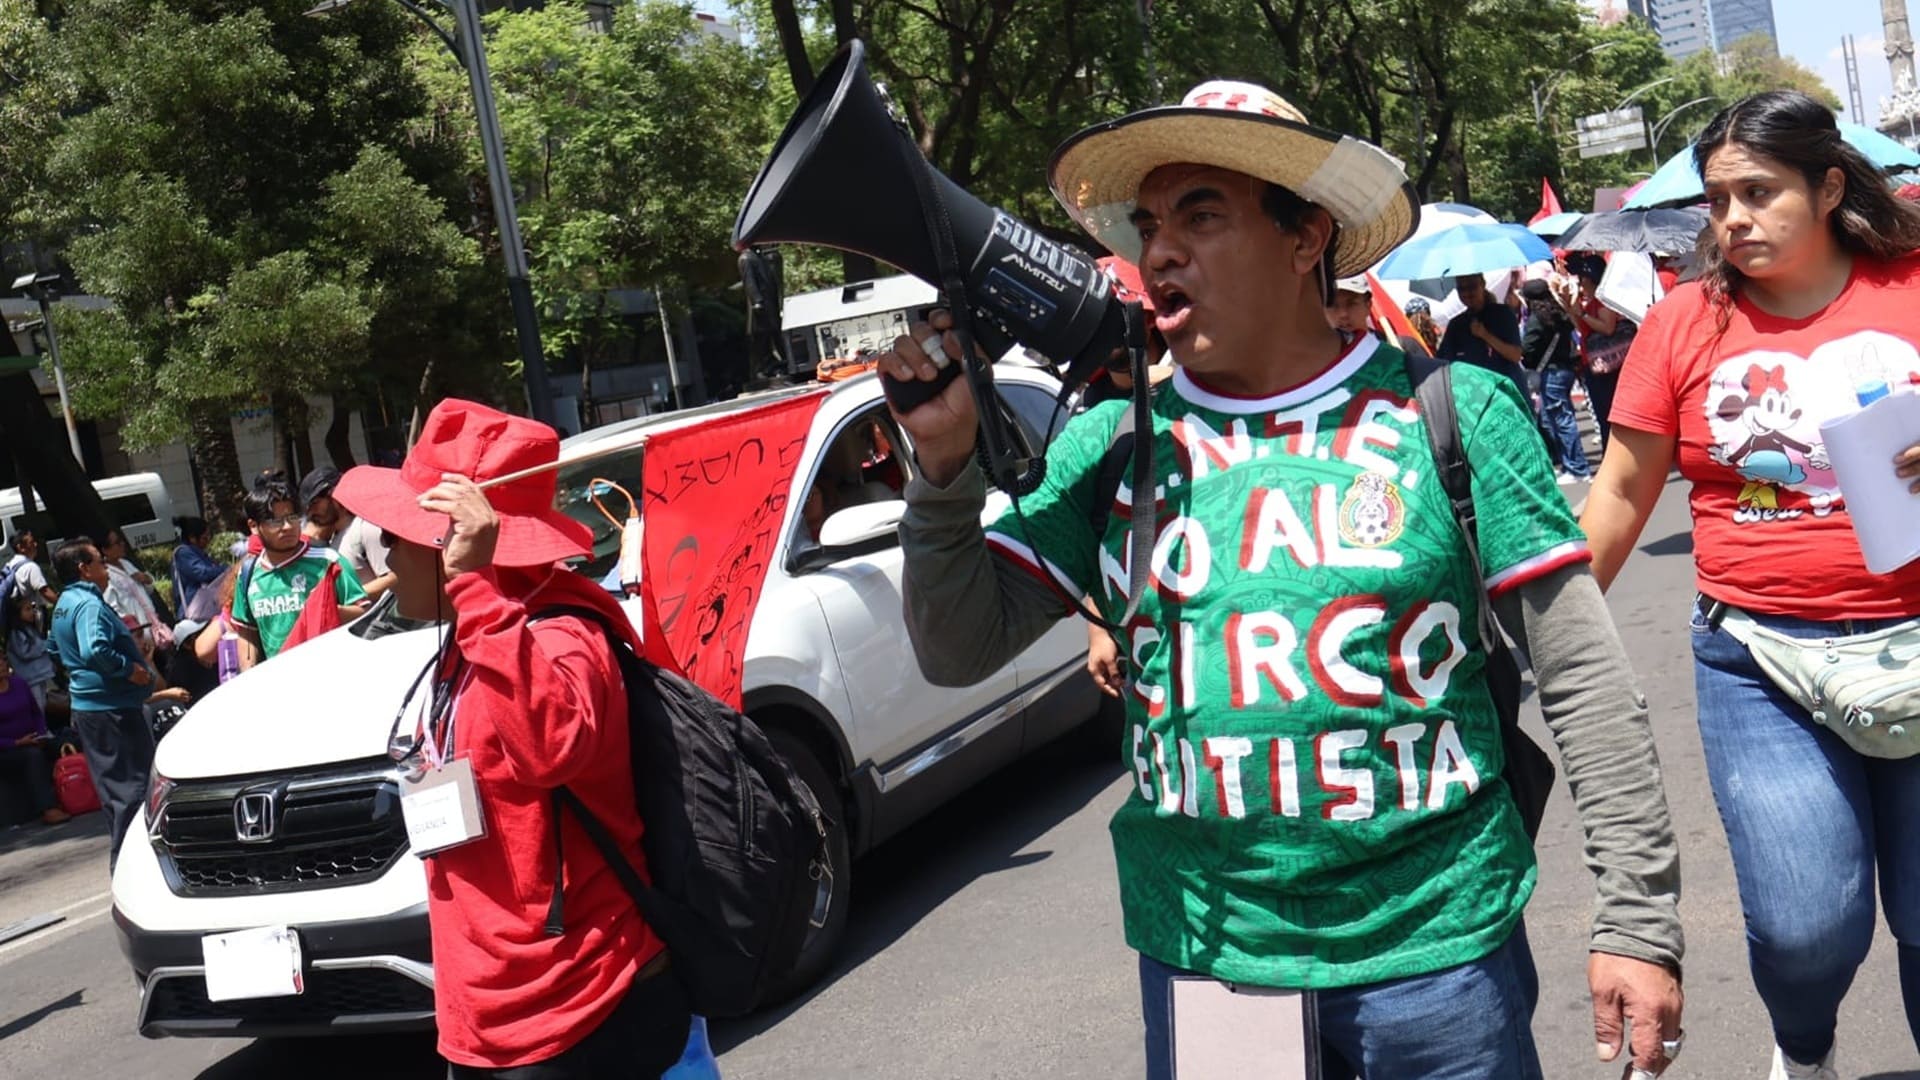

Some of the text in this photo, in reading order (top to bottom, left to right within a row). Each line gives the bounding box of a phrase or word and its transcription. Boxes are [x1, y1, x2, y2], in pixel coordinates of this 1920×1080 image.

[646, 437, 765, 508] CDMX
[1098, 483, 1402, 603] NO AL
[1127, 594, 1467, 717] CIRCO
[1132, 719, 1479, 822] ELITISTA
